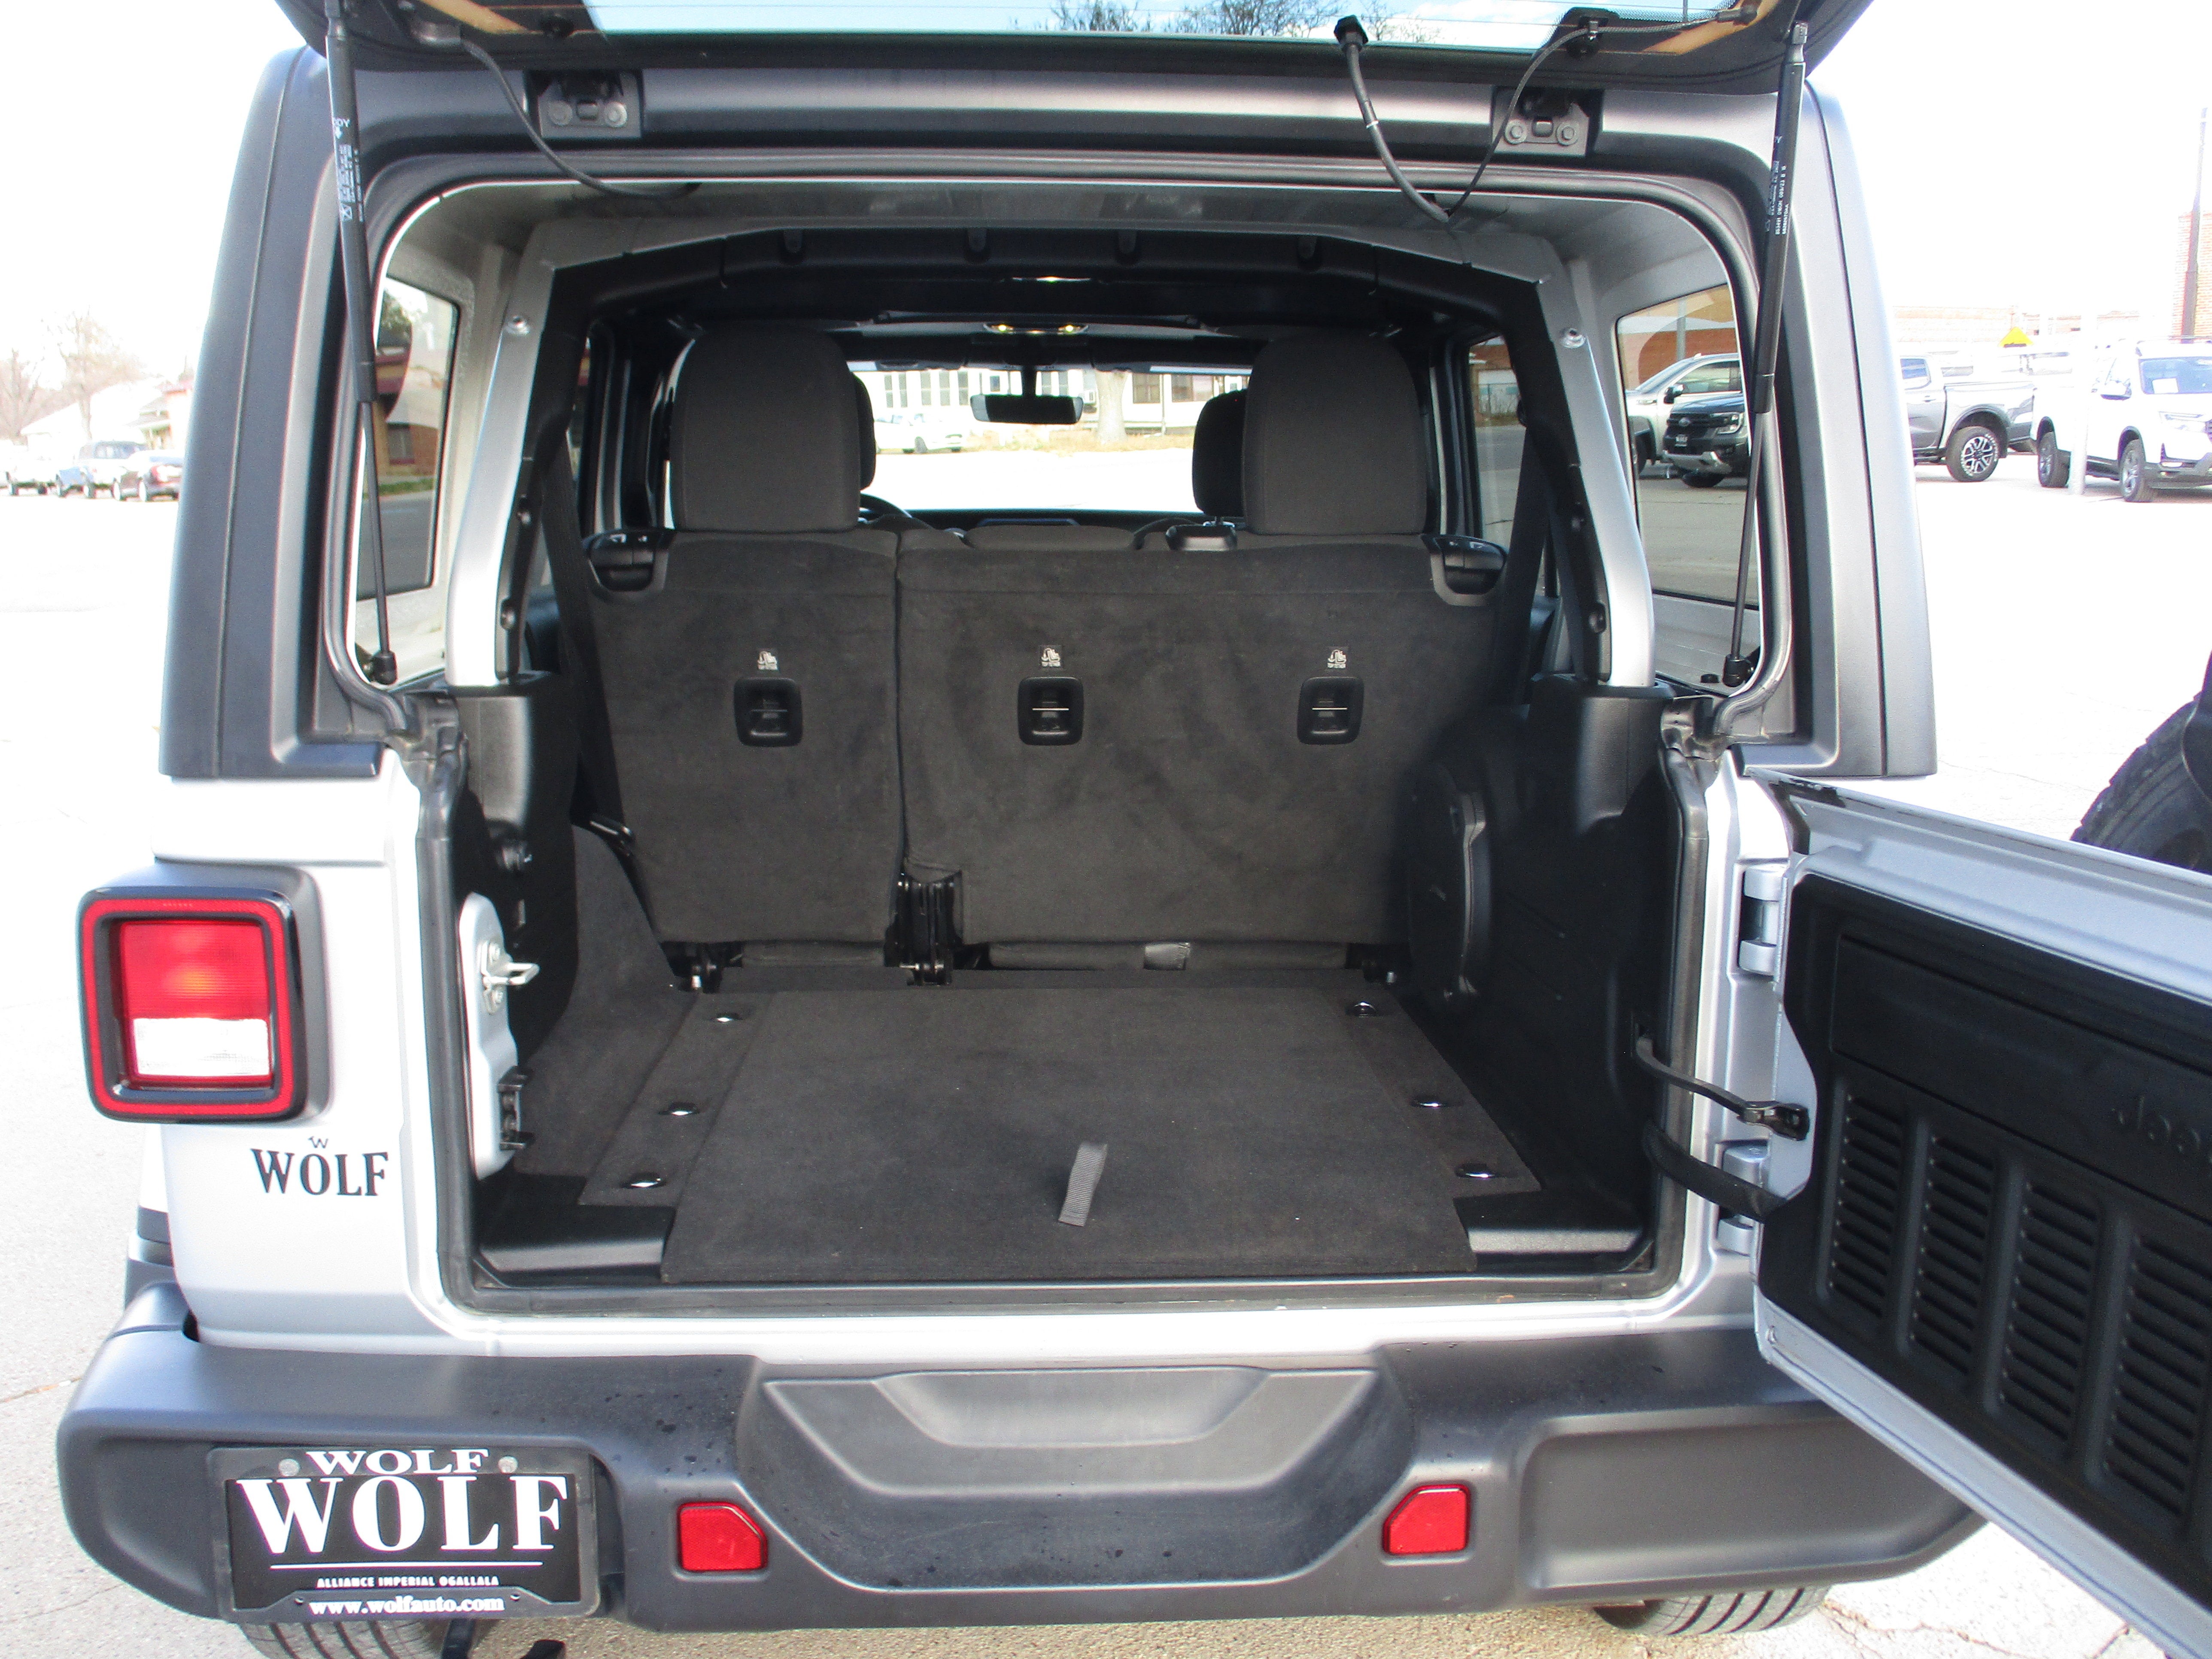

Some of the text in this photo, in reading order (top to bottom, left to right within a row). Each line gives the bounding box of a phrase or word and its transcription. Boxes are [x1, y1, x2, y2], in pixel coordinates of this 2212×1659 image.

[308, 1136, 329, 1149] W
[250, 1148, 389, 1196] WOLF
[305, 1449, 489, 1476] WOLF
[236, 1476, 568, 1554] WOLF
[316, 1576, 499, 1589] ALLIANCE IMPERIAL OGALLALA
[309, 1595, 505, 1615] www.wolfauto.com
